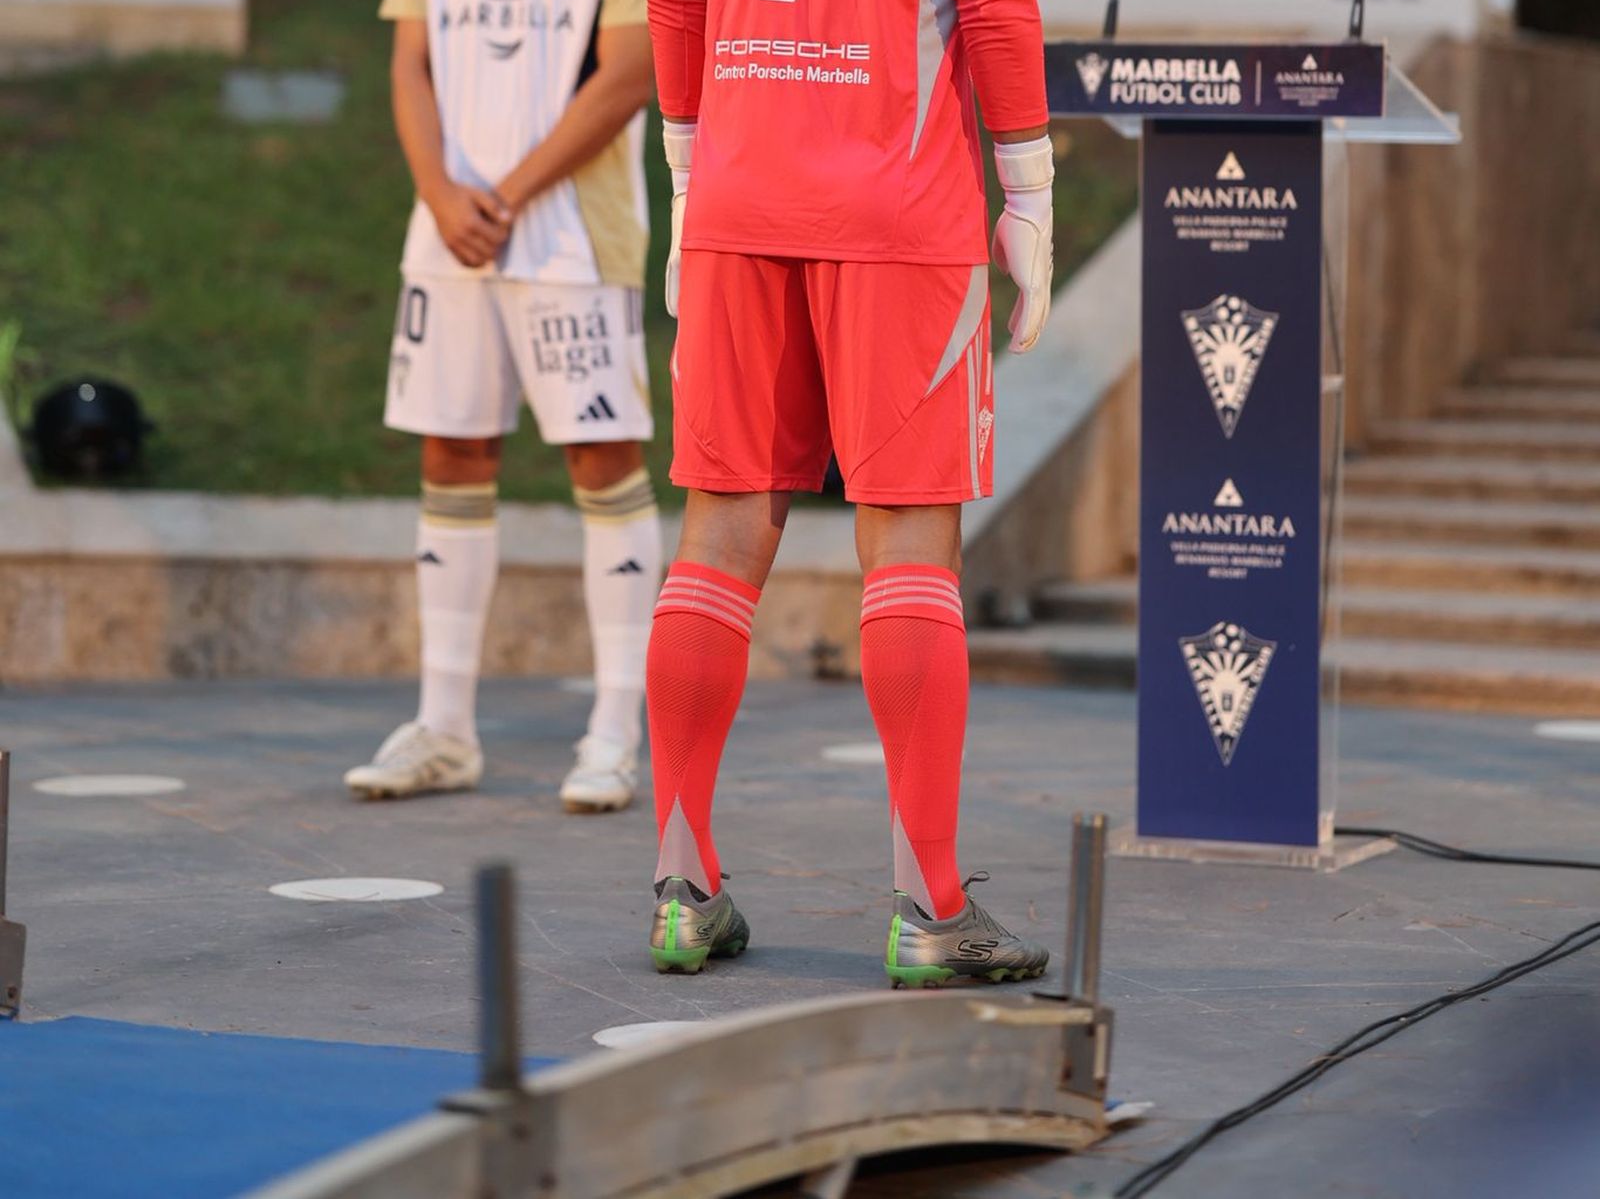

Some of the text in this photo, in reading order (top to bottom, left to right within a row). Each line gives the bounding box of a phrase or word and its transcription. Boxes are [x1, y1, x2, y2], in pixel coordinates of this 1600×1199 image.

[715, 40, 870, 60] PORSCHE
[748, 63, 803, 81] Porsche
[806, 66, 870, 84] Marbella
[1111, 58, 1241, 82] MARBELLA
[1189, 82, 1241, 105] CLUB
[1164, 186, 1298, 210] ANANTARA
[1162, 512, 1296, 538] ANANTARA
